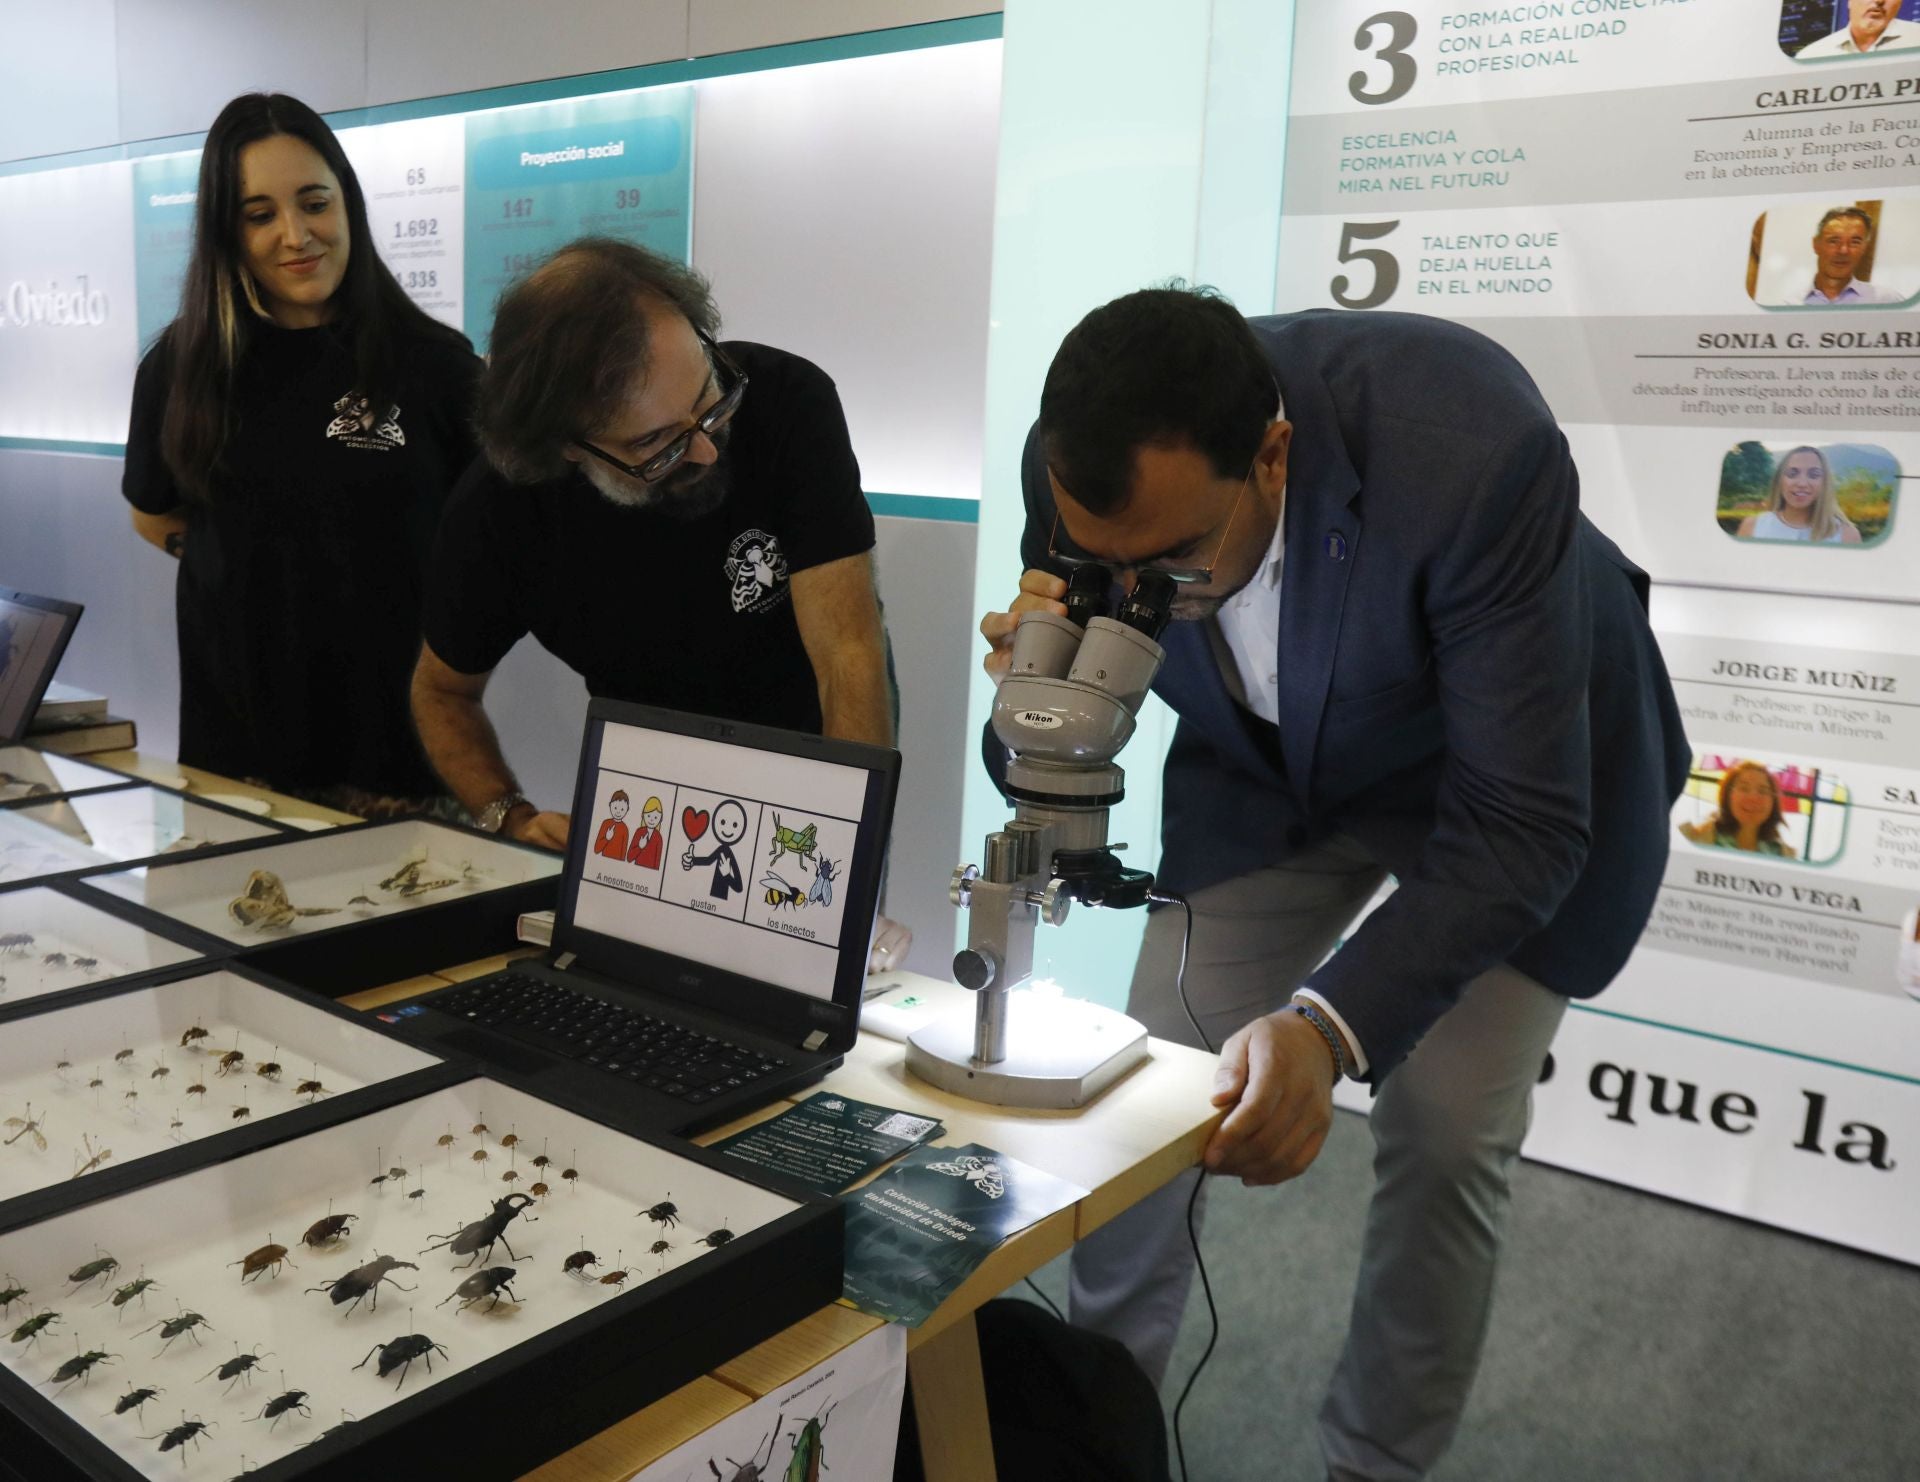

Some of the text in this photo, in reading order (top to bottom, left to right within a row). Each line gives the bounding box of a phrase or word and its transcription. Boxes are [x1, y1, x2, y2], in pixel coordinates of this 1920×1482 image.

[1441, 1, 1563, 30] FORMACIÓN
[1439, 19, 1627, 53] CON LA REALIDAD
[1348, 10, 1418, 105] 3
[1437, 49, 1579, 76] PROFESIONAL
[1756, 82, 1883, 108] CARLOTA
[1342, 130, 1457, 150] ESCELENCIA
[1743, 118, 1920, 142] Alumna de la Facu
[520, 141, 624, 167] Proyección social
[1340, 147, 1526, 173] FORMATIVA Y COLA
[1693, 147, 1778, 163] Economía
[1783, 147, 1797, 160] y
[1801, 138, 1888, 159] Empresa.
[1685, 169, 1706, 181] en
[1712, 166, 1728, 180] la
[1732, 160, 1818, 178] obtención
[1824, 158, 1847, 172] de
[1852, 153, 1896, 170] sello
[1338, 171, 1509, 194] MIRA NEL FUTURU
[503, 198, 534, 218] 147
[616, 188, 641, 209] 39
[394, 218, 438, 239] 1.692
[1422, 231, 1559, 251] TALENTO QUE
[1330, 219, 1400, 309] 5
[1420, 256, 1552, 273] DEJA HUELLA
[1417, 278, 1552, 294] EN EL MUNDO
[8, 275, 109, 328] Oviedo
[1697, 333, 1777, 349] SONIA
[1786, 333, 1810, 349] G.
[1693, 366, 1781, 381] Profesora.
[1786, 366, 1836, 381] Lleva
[1841, 367, 1879, 381] más
[1884, 367, 1908, 381] de
[1632, 383, 1698, 397] décadas
[1703, 383, 1814, 400] investigando
[1818, 385, 1867, 399] cómo
[1872, 384, 1890, 398] la
[1680, 400, 1741, 417] influye
[1745, 404, 1767, 415] en
[1771, 401, 1788, 415] la
[1792, 401, 1842, 416] salud
[1712, 660, 1898, 694] JORGE MUÑIZ
[1024, 712, 1053, 723] Nikon
[1723, 709, 1744, 724] de
[1748, 711, 1814, 732] Cultura
[1874, 709, 1892, 725] la
[596, 872, 650, 894] A nosotros nos
[1695, 870, 1862, 912] BRUNO VEGA
[690, 898, 717, 913] gustan
[767, 917, 816, 940] los insectos
[1588, 1061, 1759, 1135] que
[1792, 1087, 1897, 1172] la
[864, 1192, 967, 1241] Universidad de Oviedo
[884, 1188, 976, 1232] Colección Zoológica
